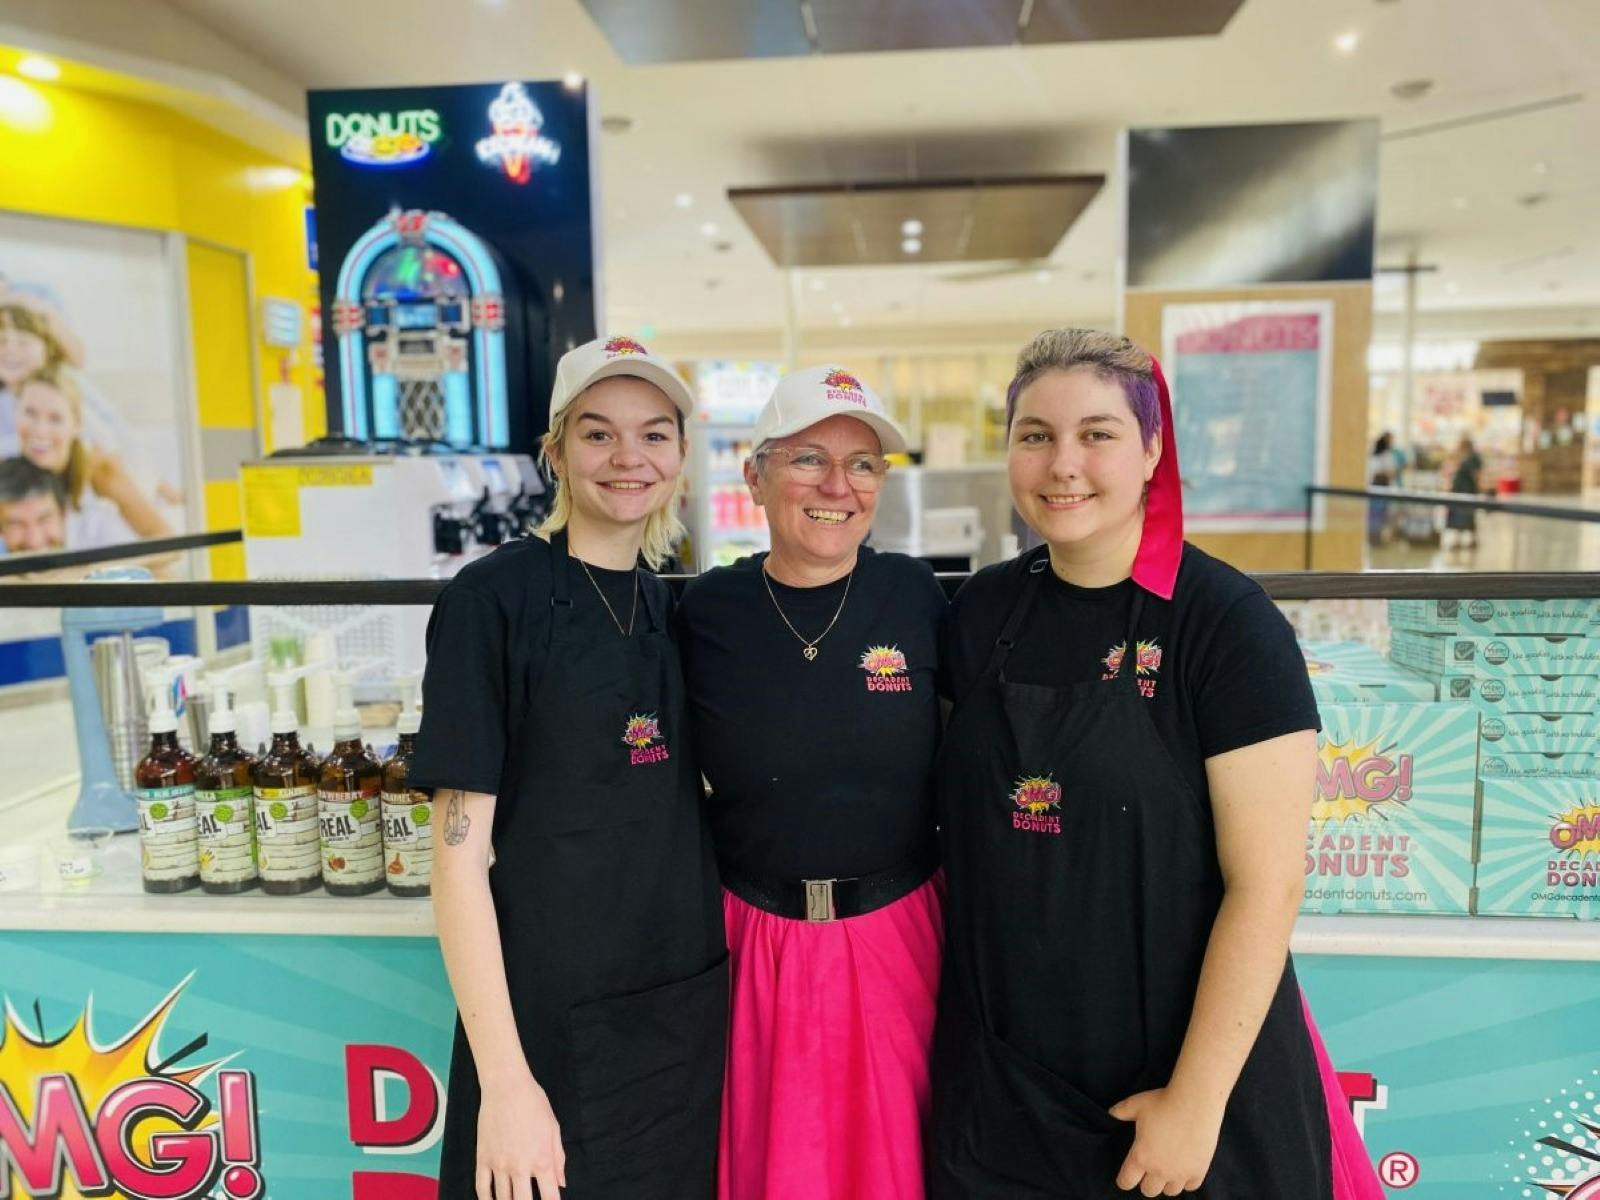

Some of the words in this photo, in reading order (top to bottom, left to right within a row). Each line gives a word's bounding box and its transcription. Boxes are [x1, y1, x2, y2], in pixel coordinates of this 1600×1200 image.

[326, 109, 440, 147] DONUTS
[867, 682, 912, 692] DONUTS
[320, 815, 356, 838] REAL
[1013, 819, 1061, 834] DONUTS
